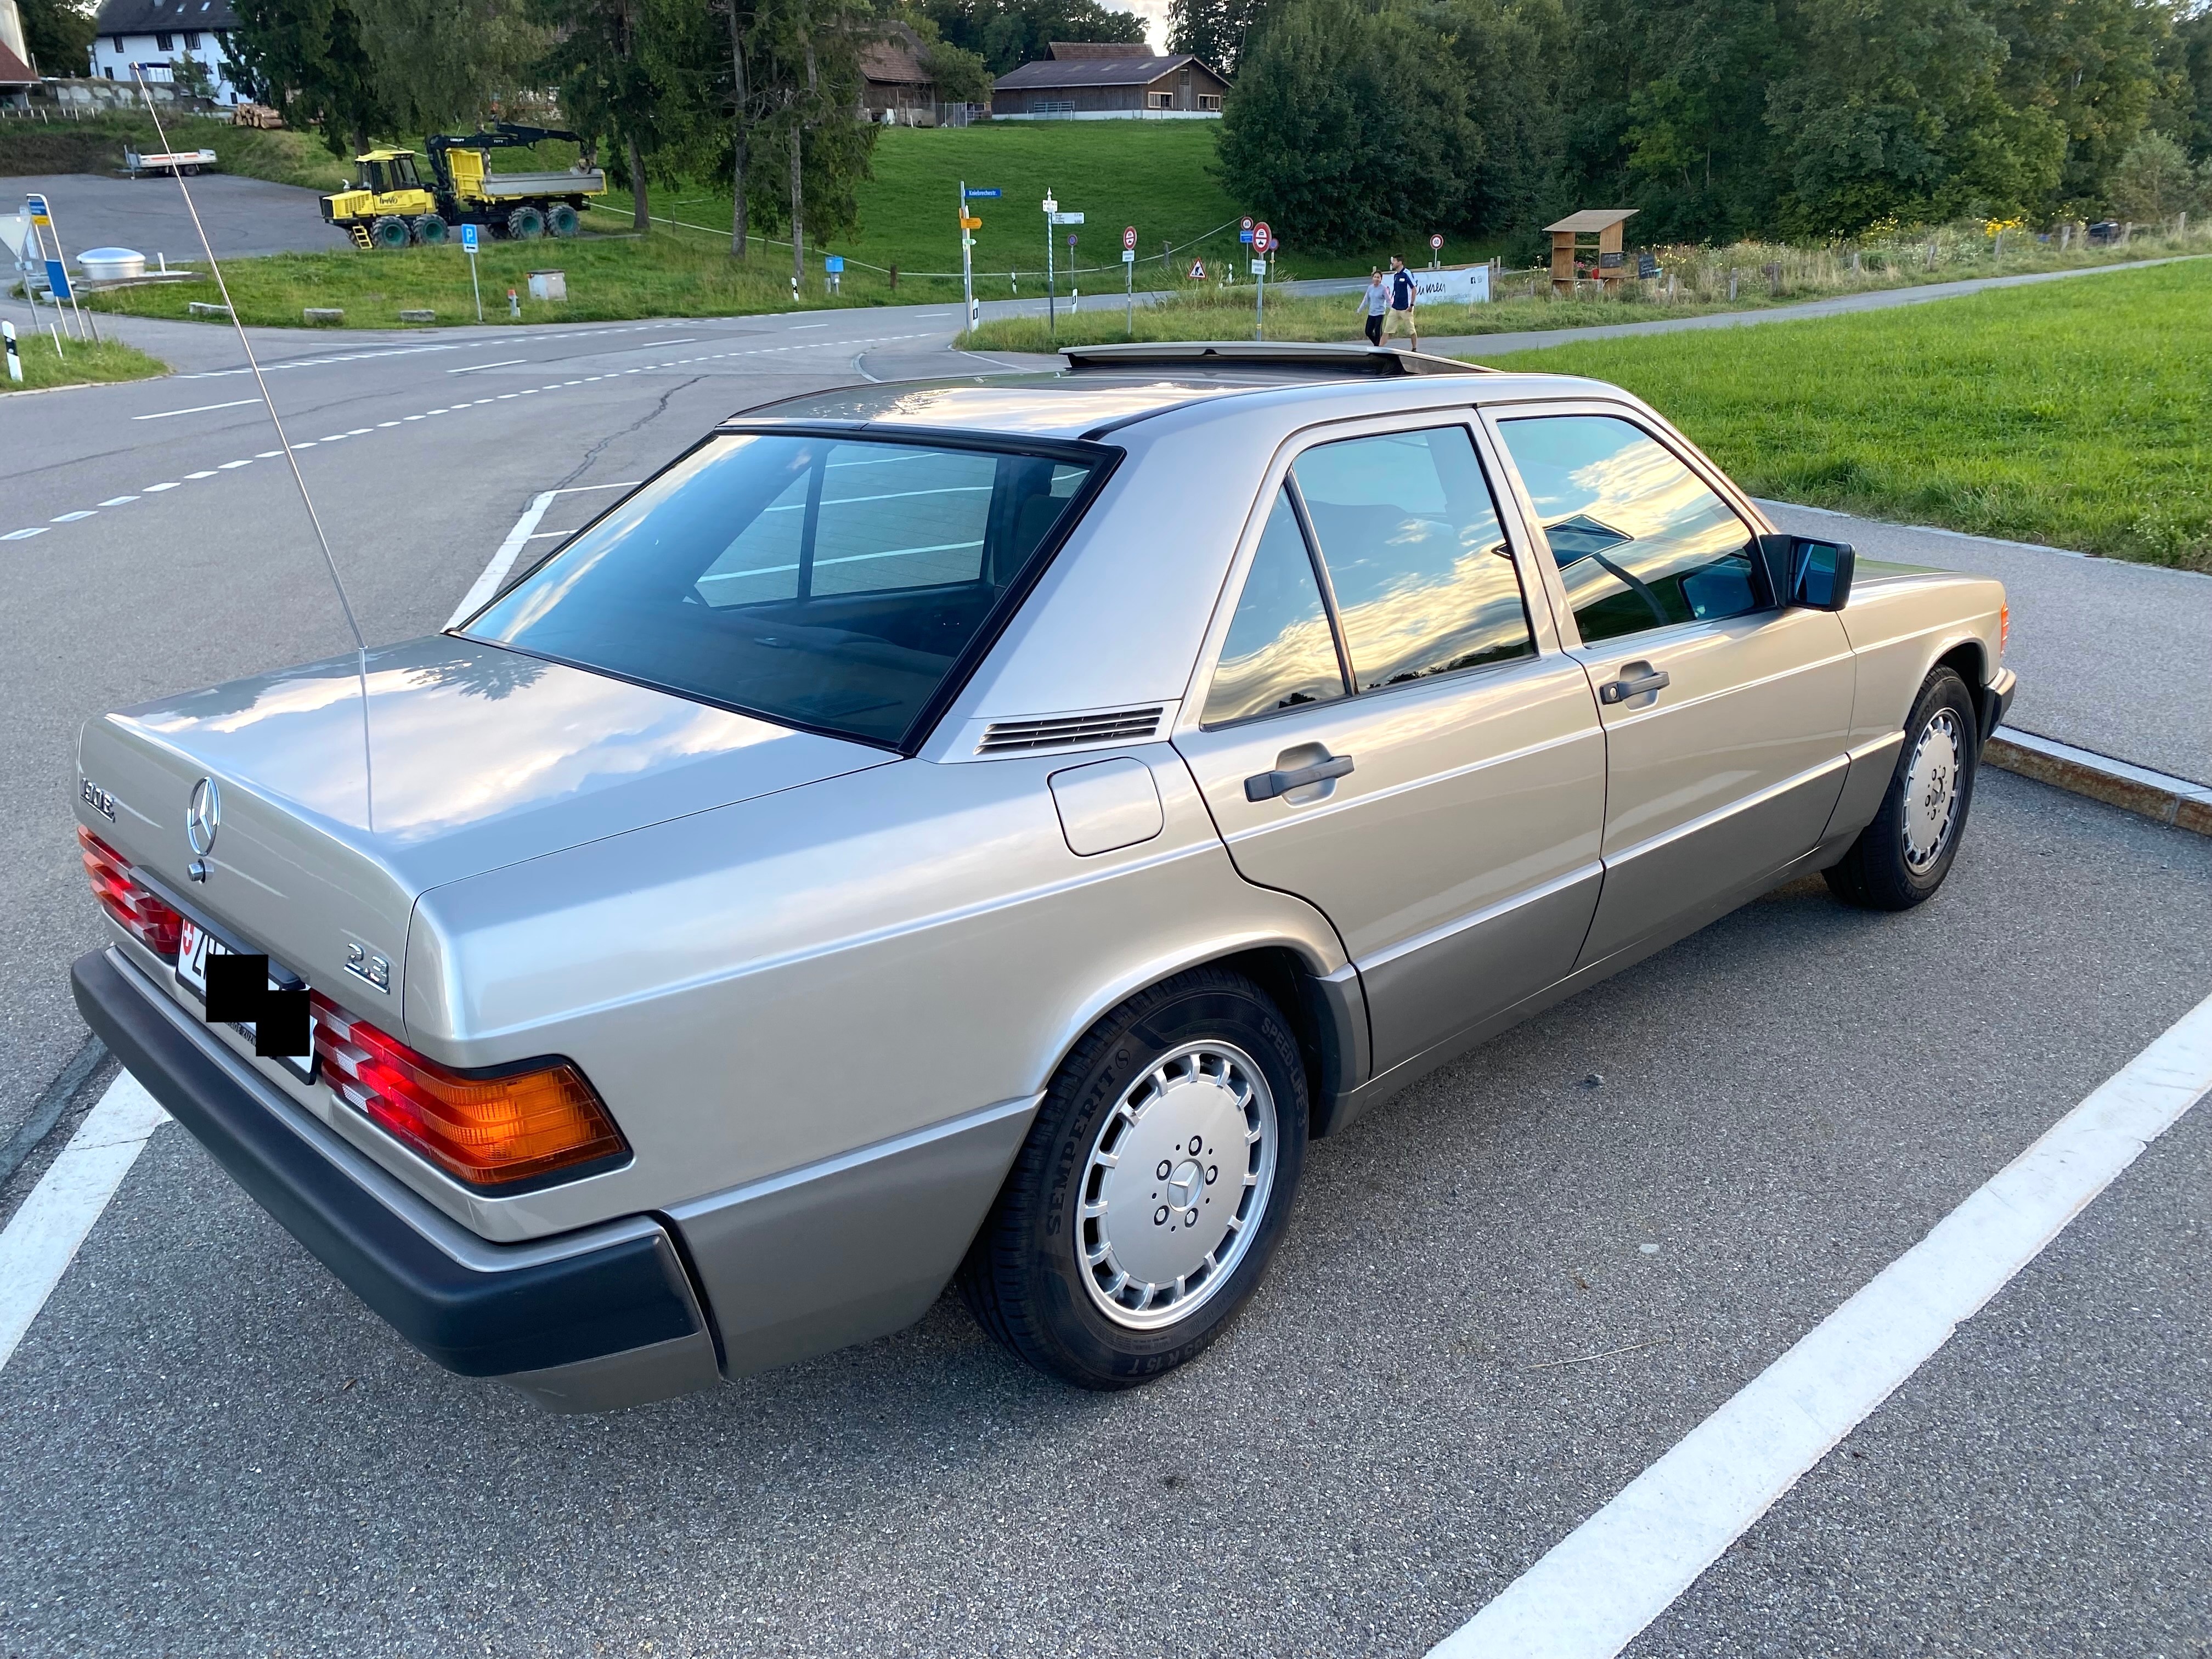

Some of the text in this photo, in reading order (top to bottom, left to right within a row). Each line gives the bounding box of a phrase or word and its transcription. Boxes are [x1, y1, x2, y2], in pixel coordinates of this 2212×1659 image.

[466, 228, 473, 242] P
[347, 943, 390, 986] 2.3
[1045, 1064, 1117, 1235] SEMPERIT
[1127, 1358, 1139, 1374] T
[1145, 1356, 1164, 1373] 15
[1167, 1350, 1180, 1366] R
